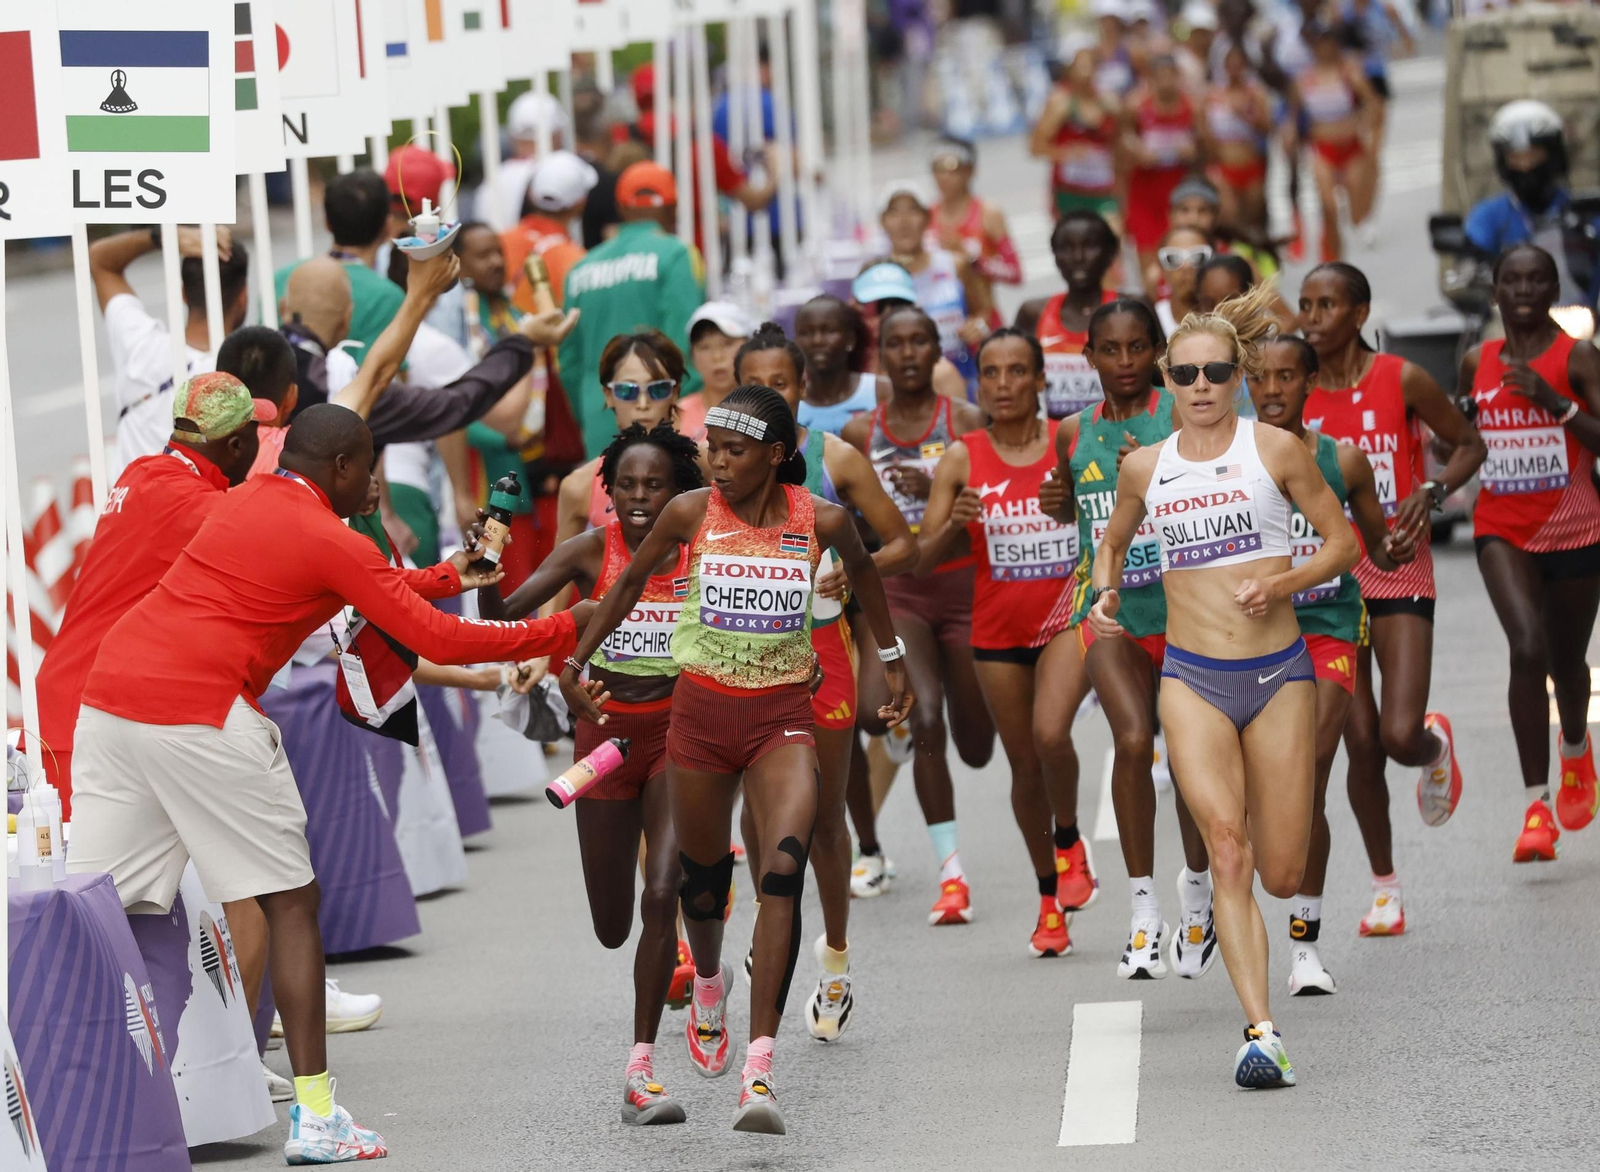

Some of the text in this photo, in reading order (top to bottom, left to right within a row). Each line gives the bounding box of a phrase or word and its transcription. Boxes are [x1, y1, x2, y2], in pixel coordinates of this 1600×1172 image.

[73, 168, 167, 209] LES
[1483, 454, 1562, 477] CHUMBA
[1154, 489, 1250, 518] HONDA
[1162, 511, 1253, 547] SULLIVAN
[994, 536, 1076, 562] ESHETE
[702, 562, 807, 582] HONDA
[705, 585, 803, 612] CHERONO
